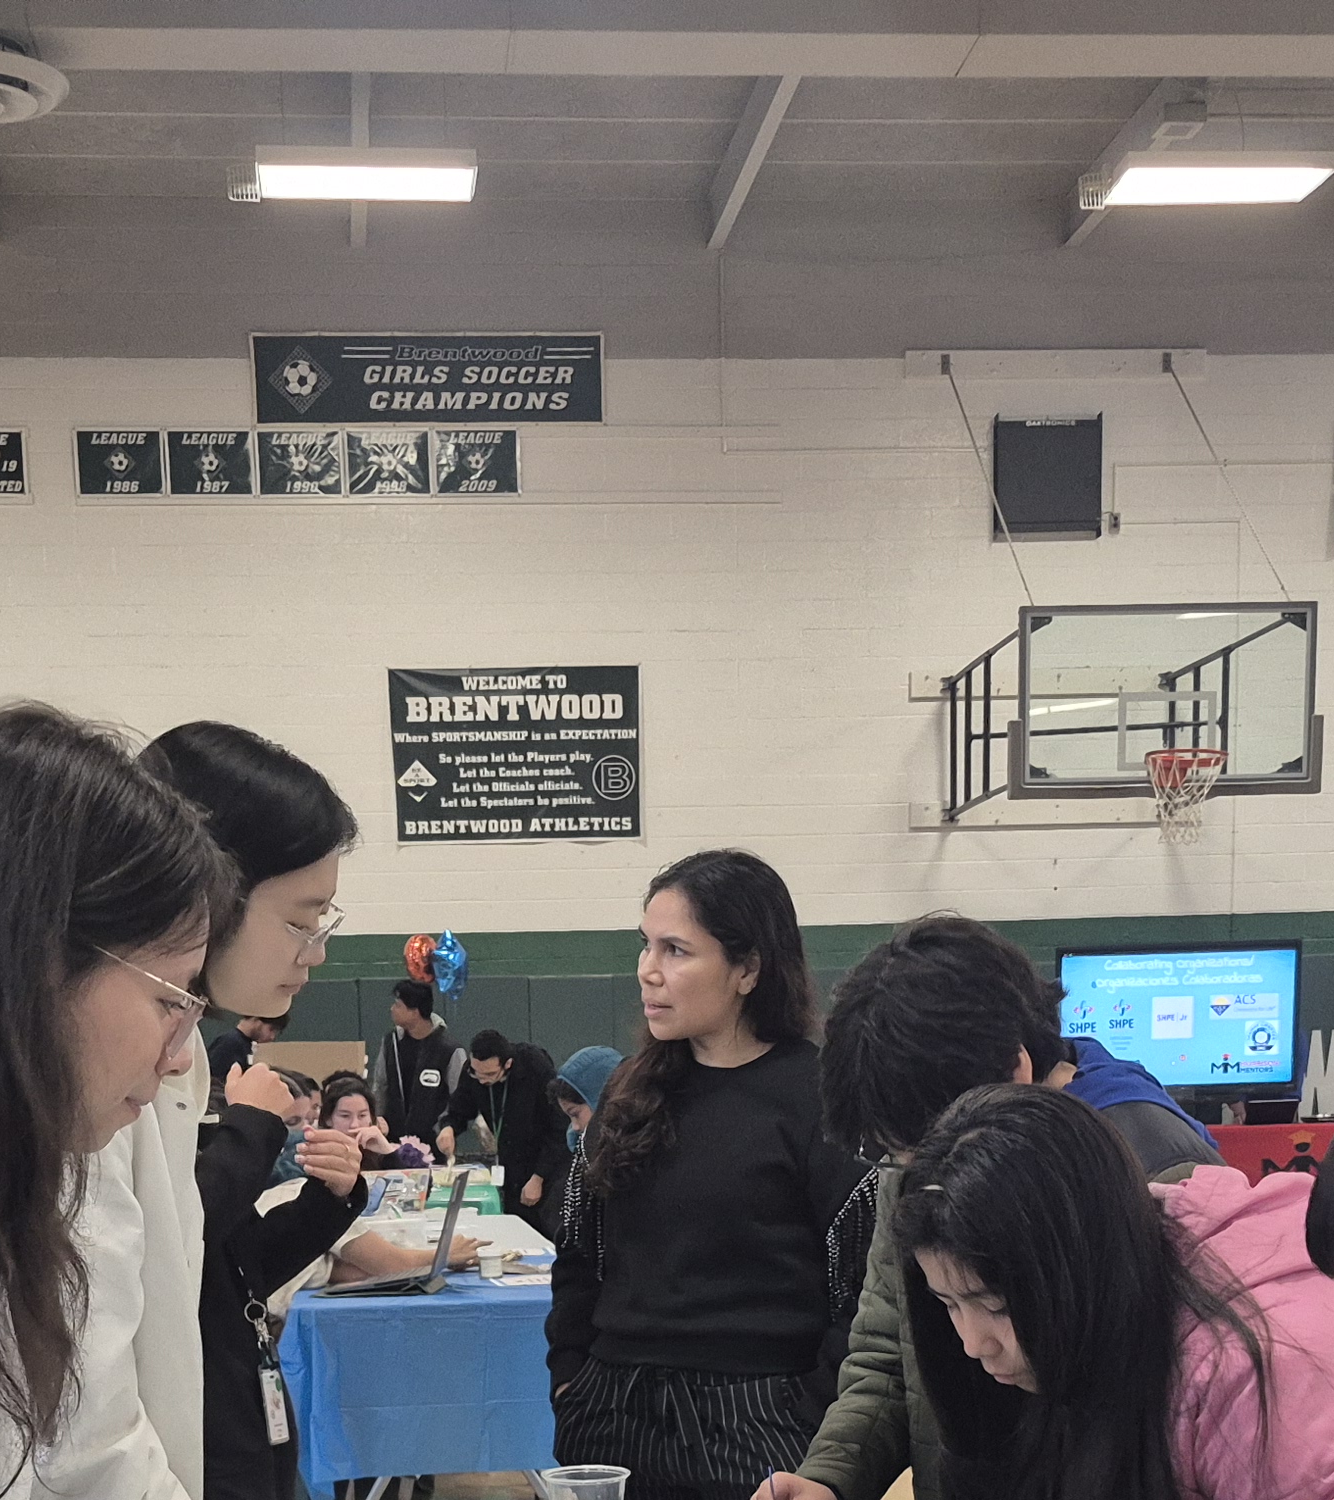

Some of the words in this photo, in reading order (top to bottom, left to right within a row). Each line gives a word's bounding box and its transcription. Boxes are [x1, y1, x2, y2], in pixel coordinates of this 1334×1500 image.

[395, 345, 542, 362] Brentwood
[363, 366, 449, 384] GIRLS
[462, 367, 574, 385] SOCCER
[369, 392, 569, 410] CHAMPIONS
[90, 433, 146, 445] LEAGUE
[180, 433, 236, 446] LEAGUE
[450, 432, 503, 443] LEAGUE
[2, 460, 17, 472] 19
[106, 480, 139, 493] 1986
[196, 481, 230, 493] 1987
[459, 480, 497, 492] 2009
[461, 676, 542, 690] WELCOME
[546, 675, 567, 689] TO
[405, 694, 624, 722] BRENTWOOD
[394, 733, 428, 743] Where
[432, 731, 528, 742] SPORTSMANSHIP
[531, 732, 541, 741] is
[544, 732, 556, 740] an
[560, 729, 637, 740] EXPECTATION
[439, 753, 452, 763] So
[455, 753, 488, 766] please
[491, 753, 505, 763] let
[508, 753, 524, 762] the
[527, 752, 566, 764] Players
[569, 751, 594, 763] play.
[459, 768, 476, 778] Let
[479, 768, 496, 777] the
[498, 767, 540, 777] Coaches
[543, 766, 575, 776] coach.
[452, 783, 469, 793] Let
[473, 783, 488, 792] the
[492, 782, 535, 792] Officials
[538, 781, 583, 791] officials.
[440, 798, 458, 808] Let
[461, 798, 477, 807] the
[480, 797, 534, 809] Spectators
[537, 796, 549, 806] be
[552, 795, 595, 807] positive.
[405, 820, 522, 834] BRENTWOOD
[530, 817, 632, 832] ATHLETICS
[1104, 959, 1173, 975] Collaborating
[1096, 975, 1179, 993] organizaciones
[1182, 972, 1263, 985] Colaboradoras
[1234, 995, 1256, 1004] ACS
[1068, 1022, 1096, 1034] SHPE
[1109, 1019, 1134, 1029] SHPE
